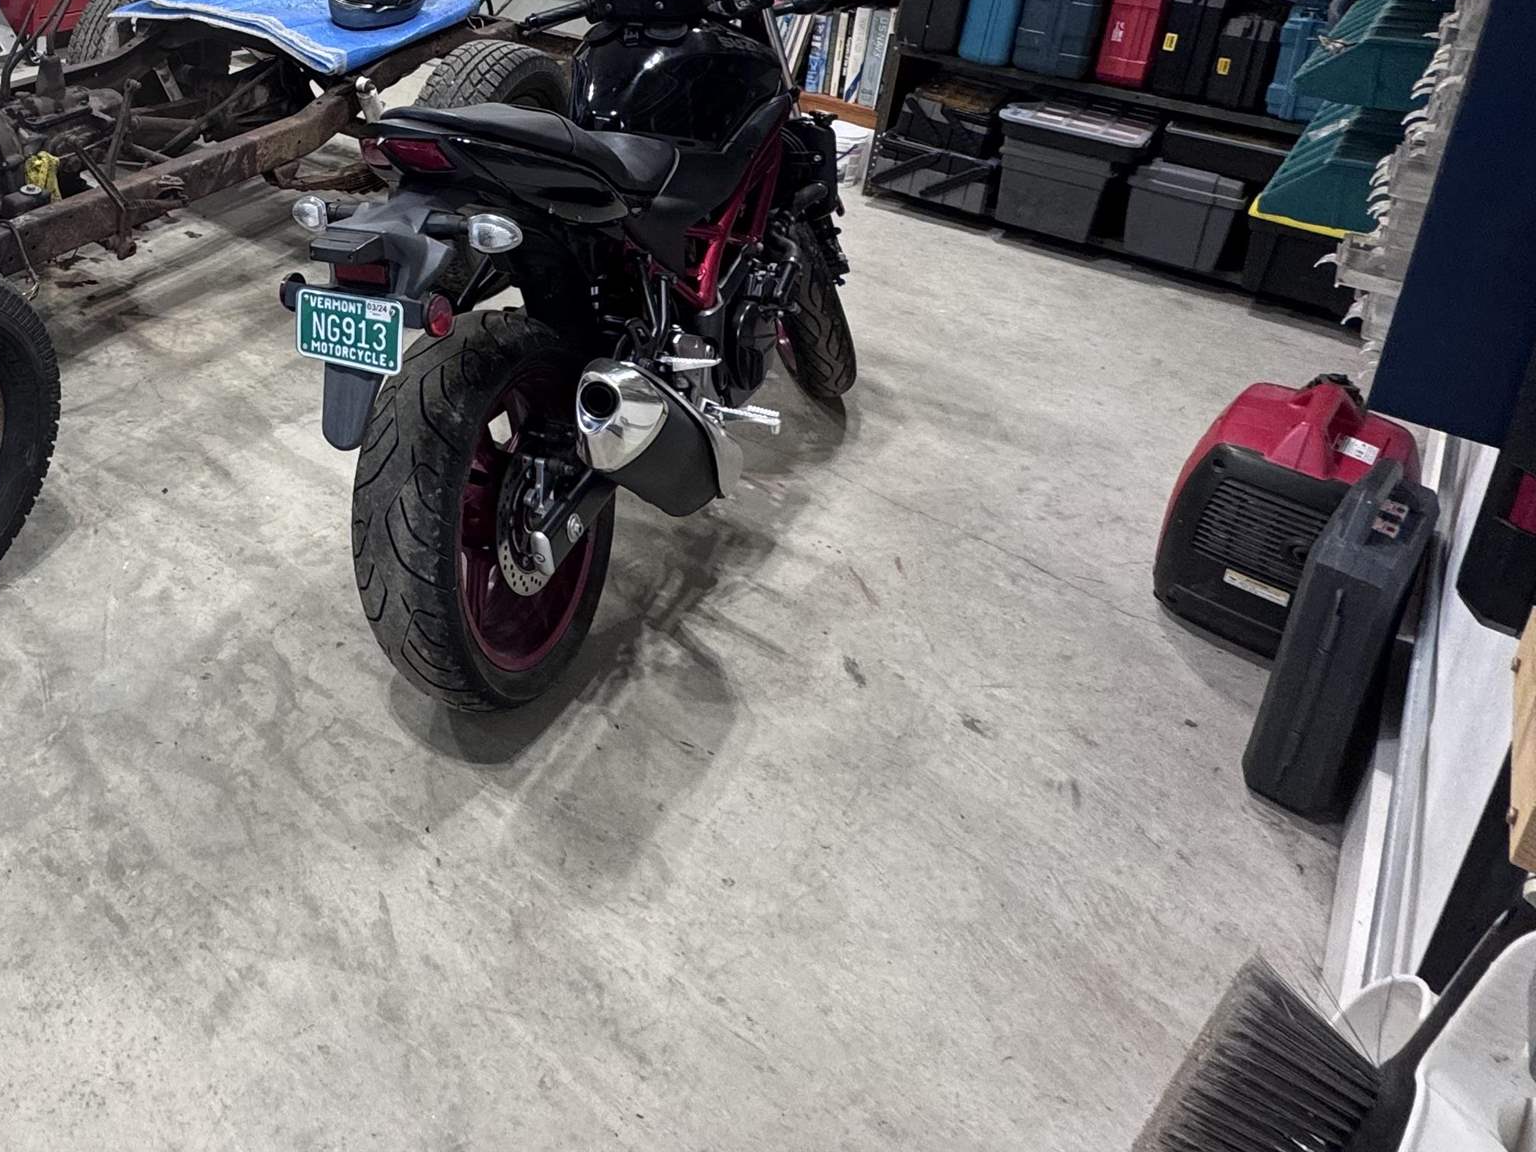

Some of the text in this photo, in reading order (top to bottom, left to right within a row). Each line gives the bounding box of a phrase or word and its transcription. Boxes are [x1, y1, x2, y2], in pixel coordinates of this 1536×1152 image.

[310, 296, 363, 315] VERMONT
[367, 303, 387, 314] 03/24
[313, 311, 386, 351] NG913
[311, 339, 387, 367] MOTORCYCLE
